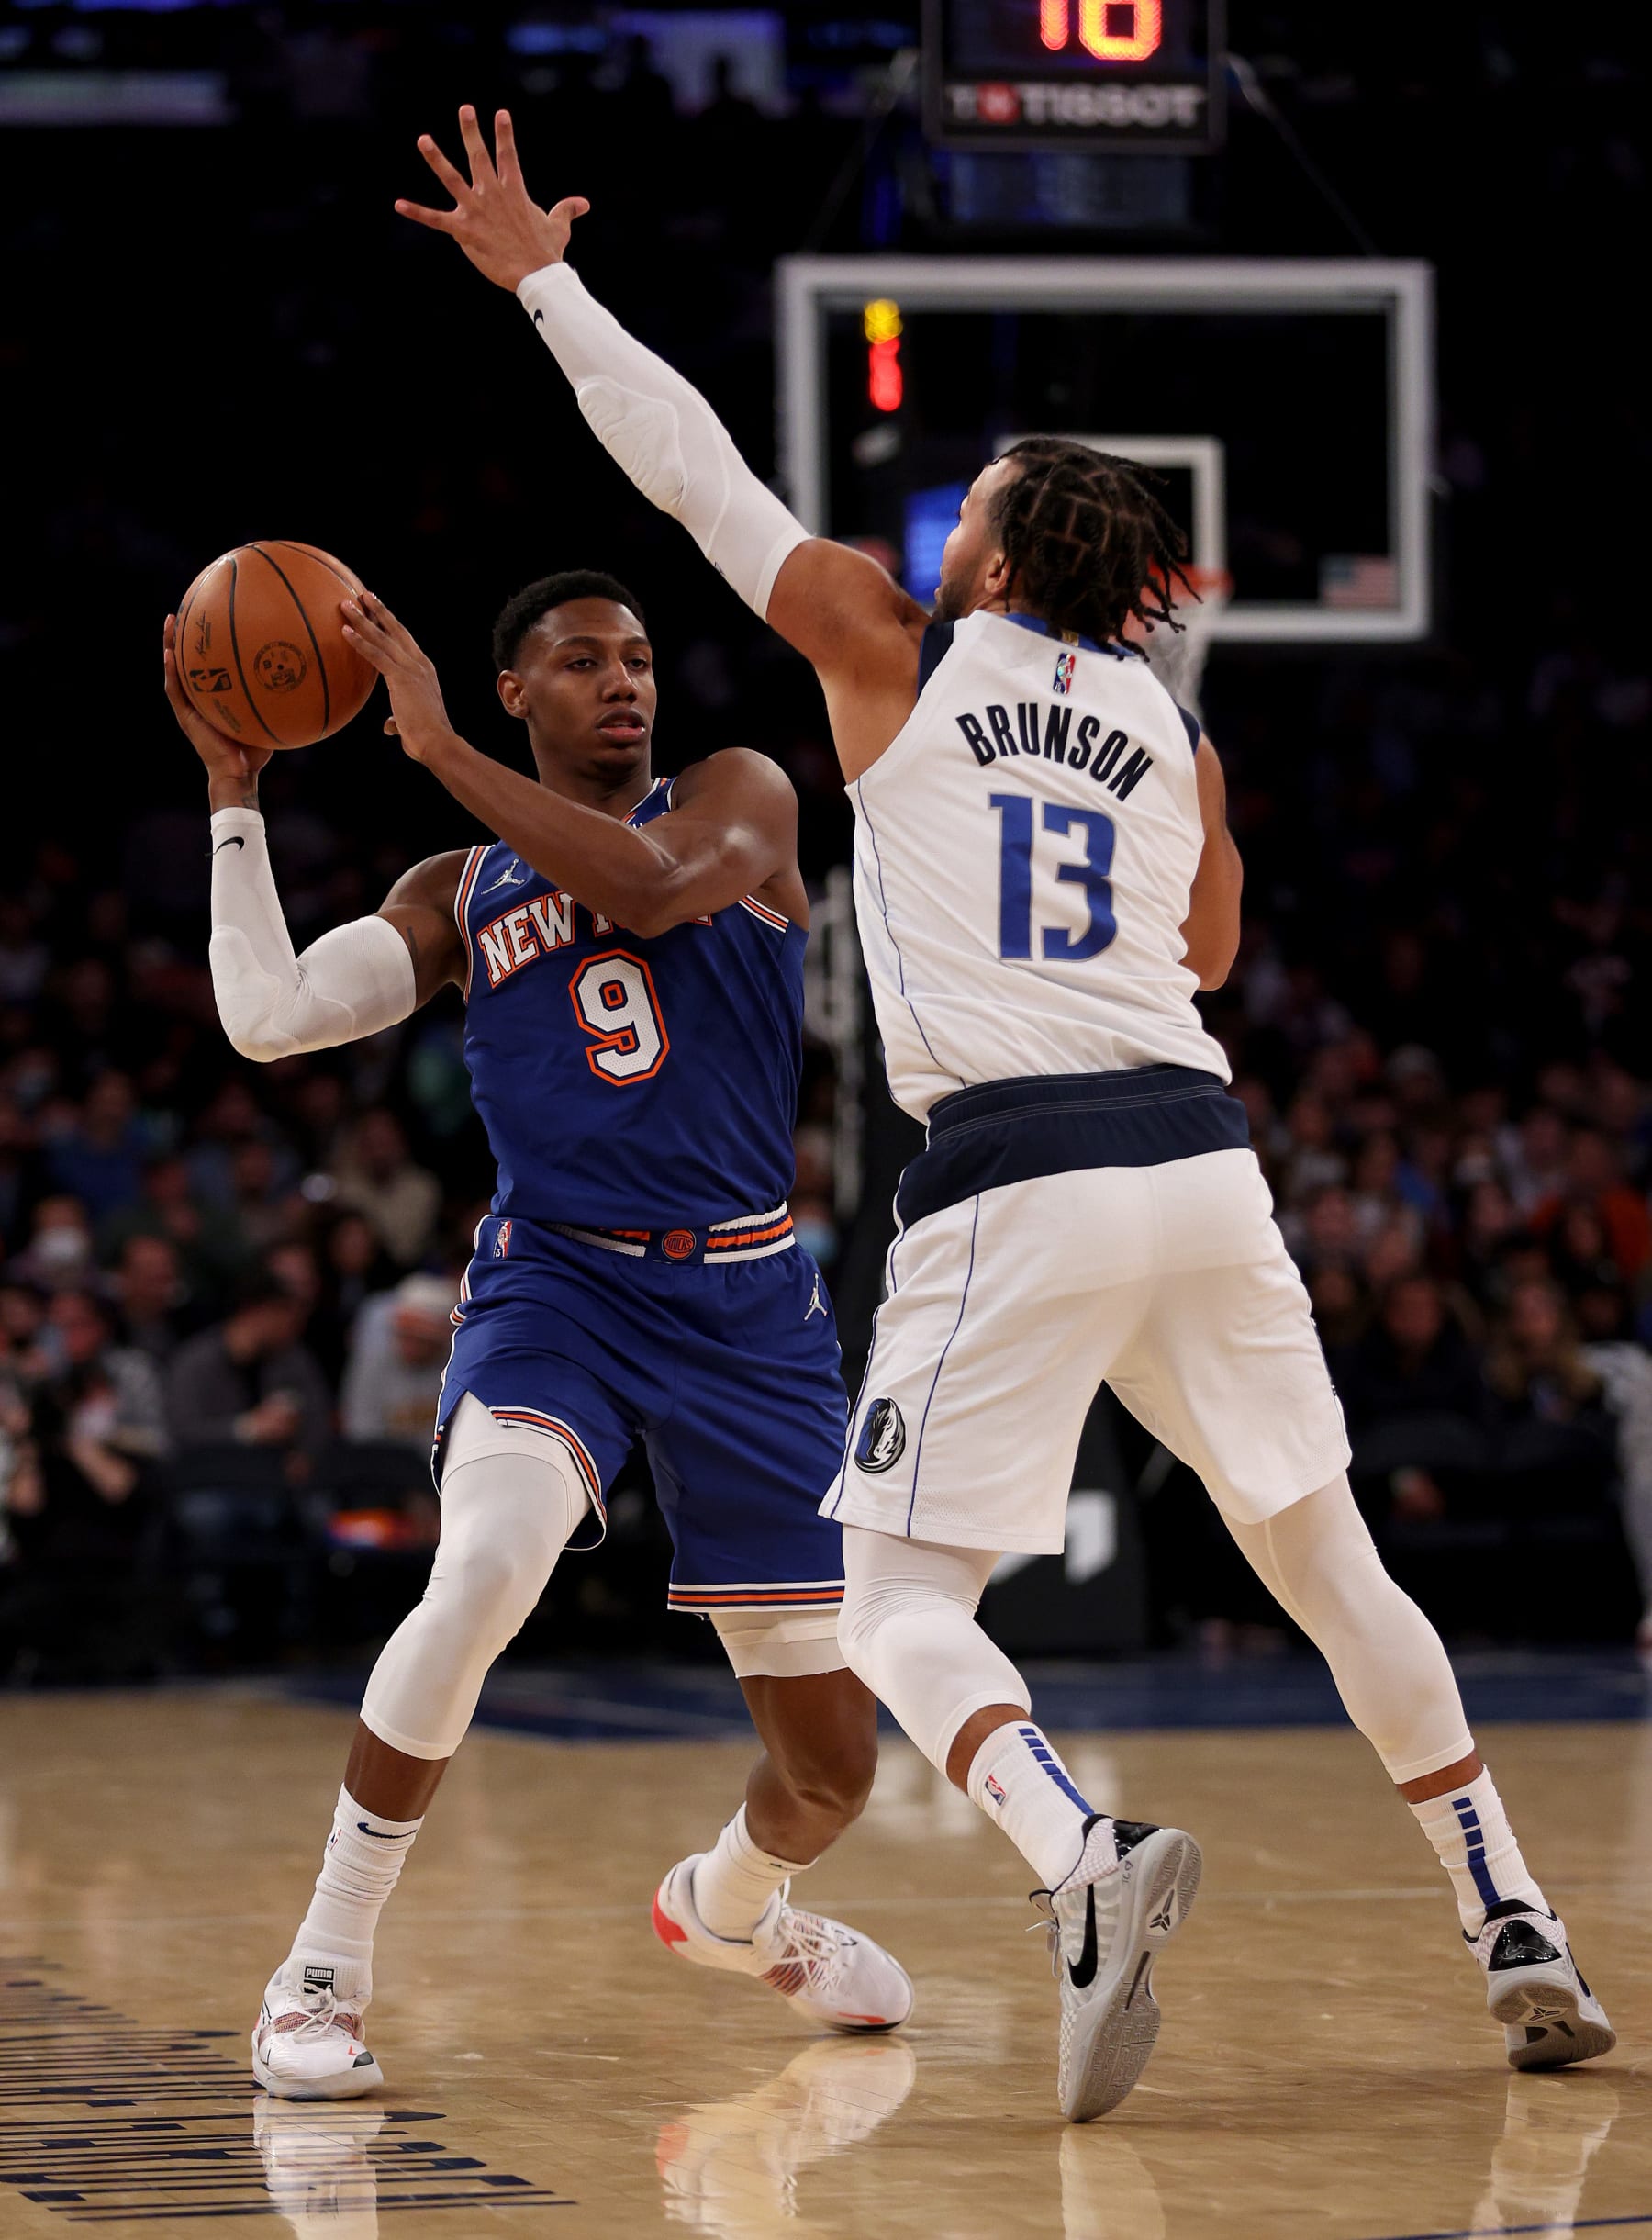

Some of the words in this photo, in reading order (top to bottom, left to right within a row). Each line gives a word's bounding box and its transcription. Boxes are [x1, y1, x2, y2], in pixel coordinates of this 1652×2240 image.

[1018, 84, 1203, 126] TISSOT
[955, 702, 1153, 801] BRUNSON
[988, 791, 1118, 962] 13
[477, 890, 575, 989] NEW
[568, 948, 670, 1087] 9
[306, 1967, 333, 1979] PUMA
